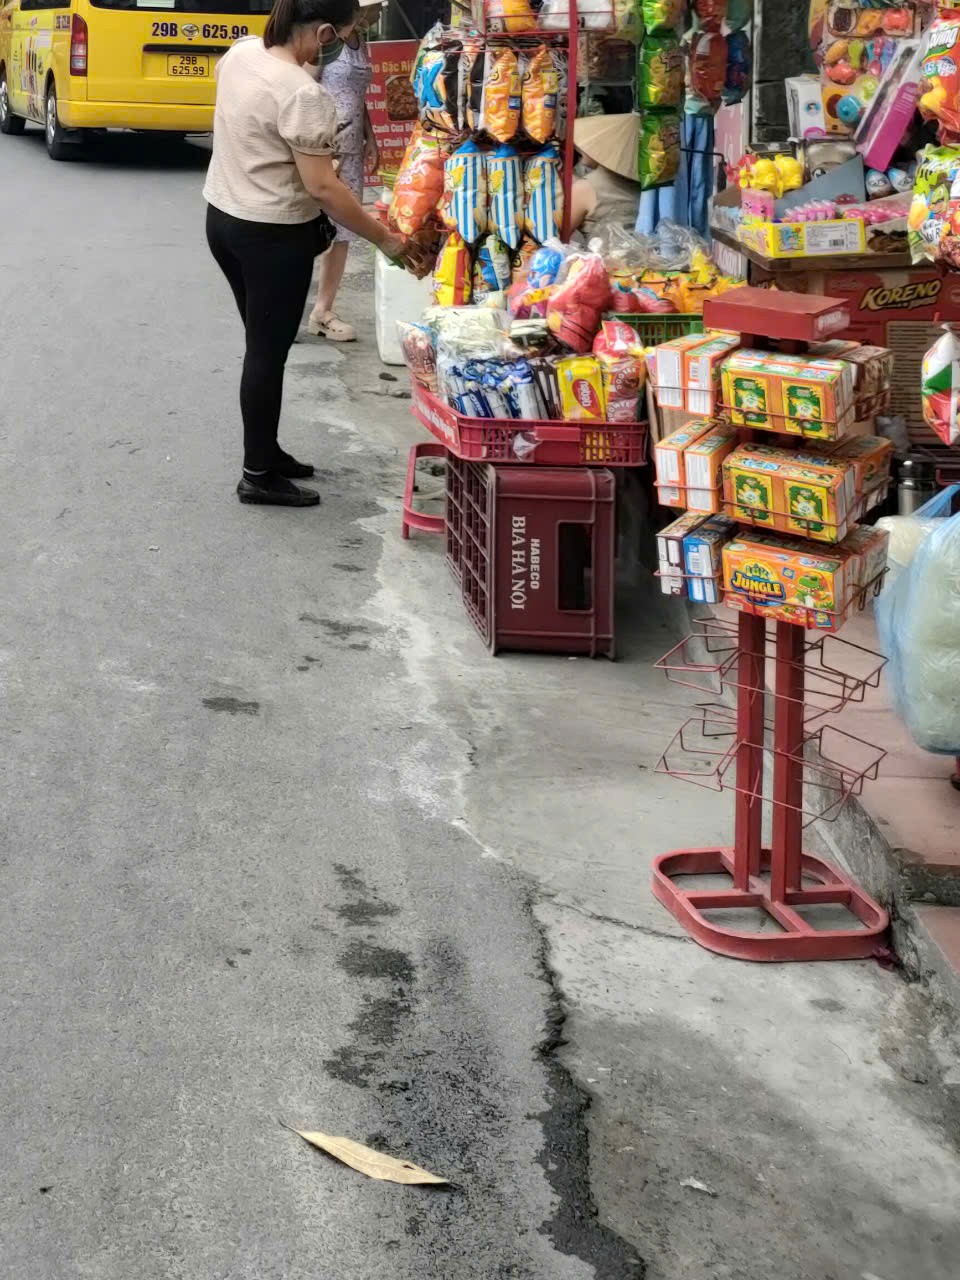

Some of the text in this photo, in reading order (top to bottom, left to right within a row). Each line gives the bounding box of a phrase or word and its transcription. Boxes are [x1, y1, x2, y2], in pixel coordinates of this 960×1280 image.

[151, 22, 249, 40] 29B 625.99
[172, 66, 204, 75] 625.99
[179, 56, 197, 65] 29B
[859, 280, 942, 311] KORENO
[512, 516, 526, 546] BIA
[530, 538, 541, 590] HABECO
[509, 579, 528, 610] NỘI
[732, 572, 782, 596] JUNGLE
